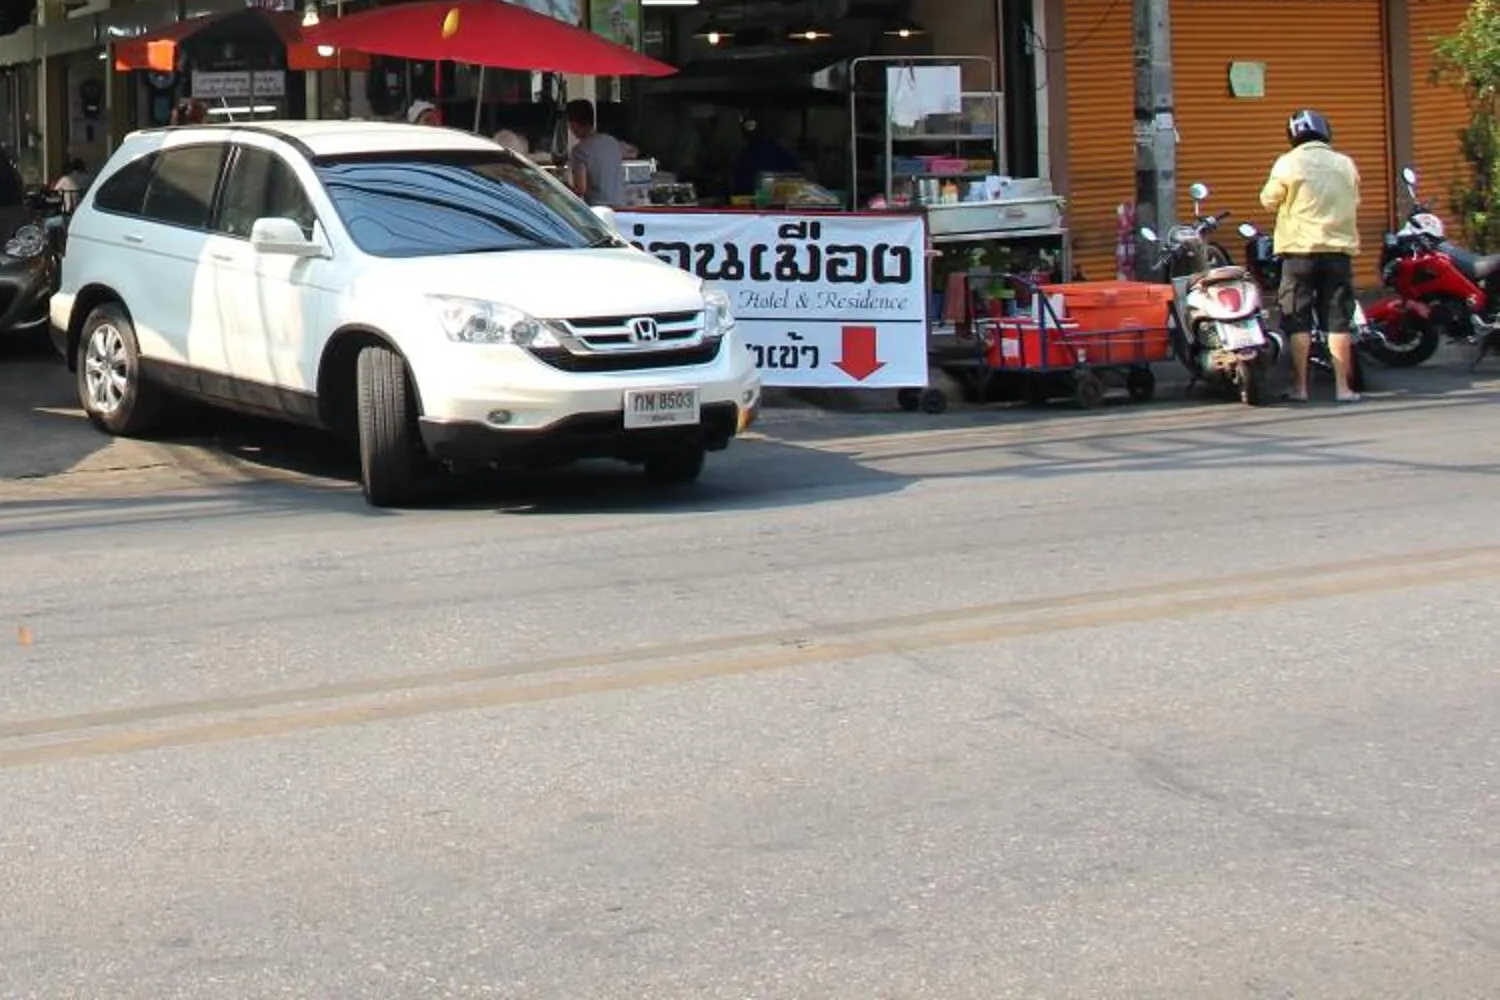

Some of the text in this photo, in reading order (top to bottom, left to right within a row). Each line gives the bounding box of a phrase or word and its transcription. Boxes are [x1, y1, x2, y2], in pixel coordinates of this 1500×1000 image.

[631, 221, 913, 284] ่อนเมือง
[738, 287, 909, 311] Hotel & Residence
